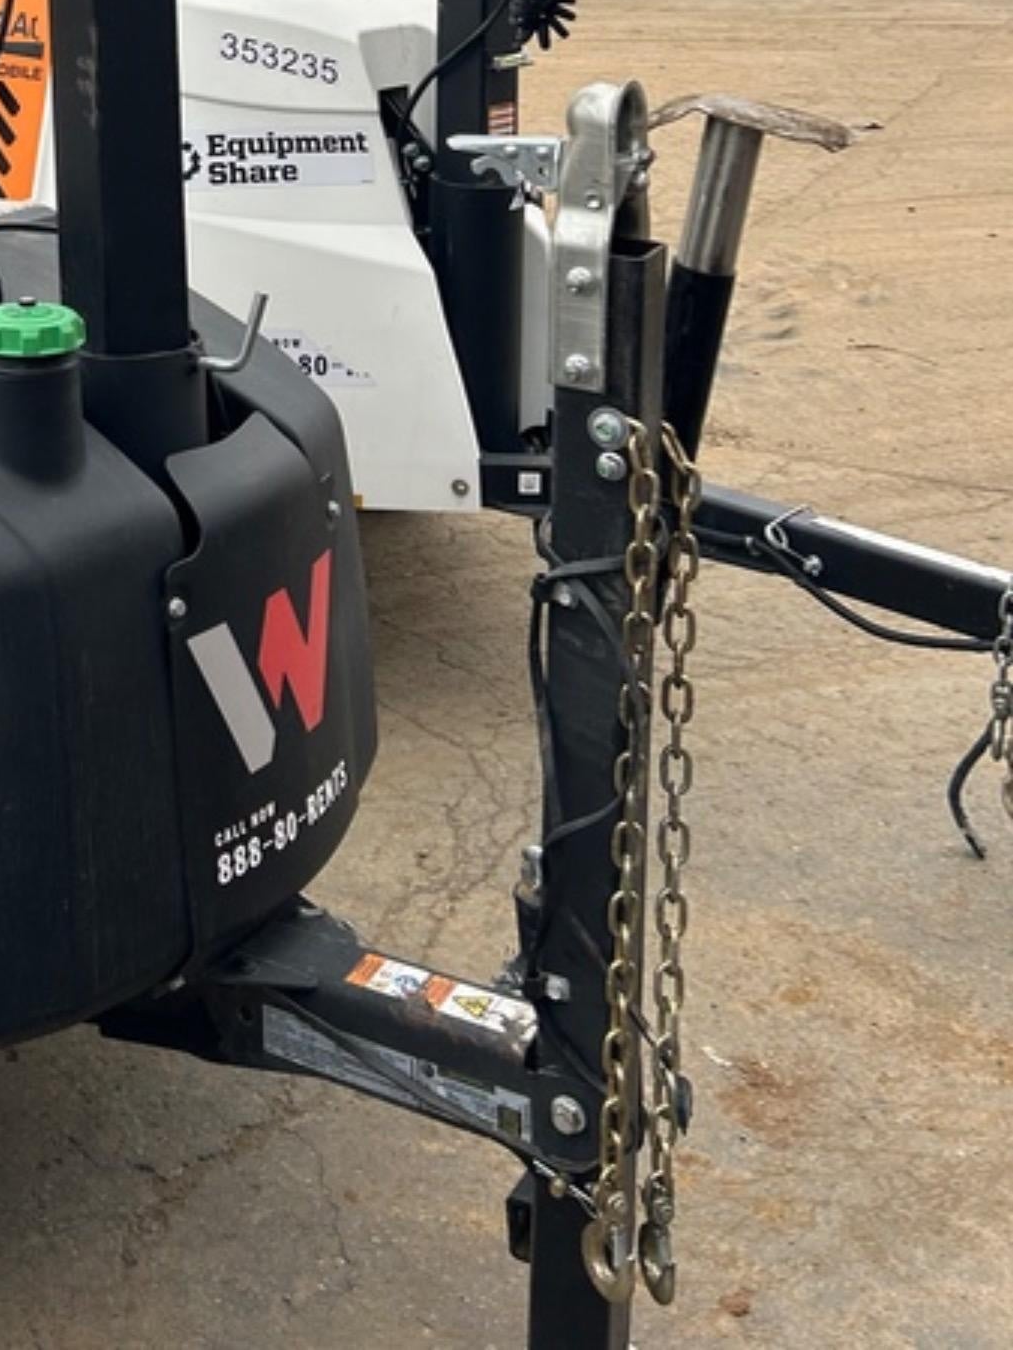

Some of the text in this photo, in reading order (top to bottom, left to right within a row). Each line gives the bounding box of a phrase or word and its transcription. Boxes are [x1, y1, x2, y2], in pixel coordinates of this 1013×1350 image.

[220, 31, 339, 85] 353235
[206, 131, 370, 161] Equipment
[207, 161, 299, 185] Share
[214, 801, 276, 848] CALL NOW
[217, 759, 349, 885] 888-80-RENTS
